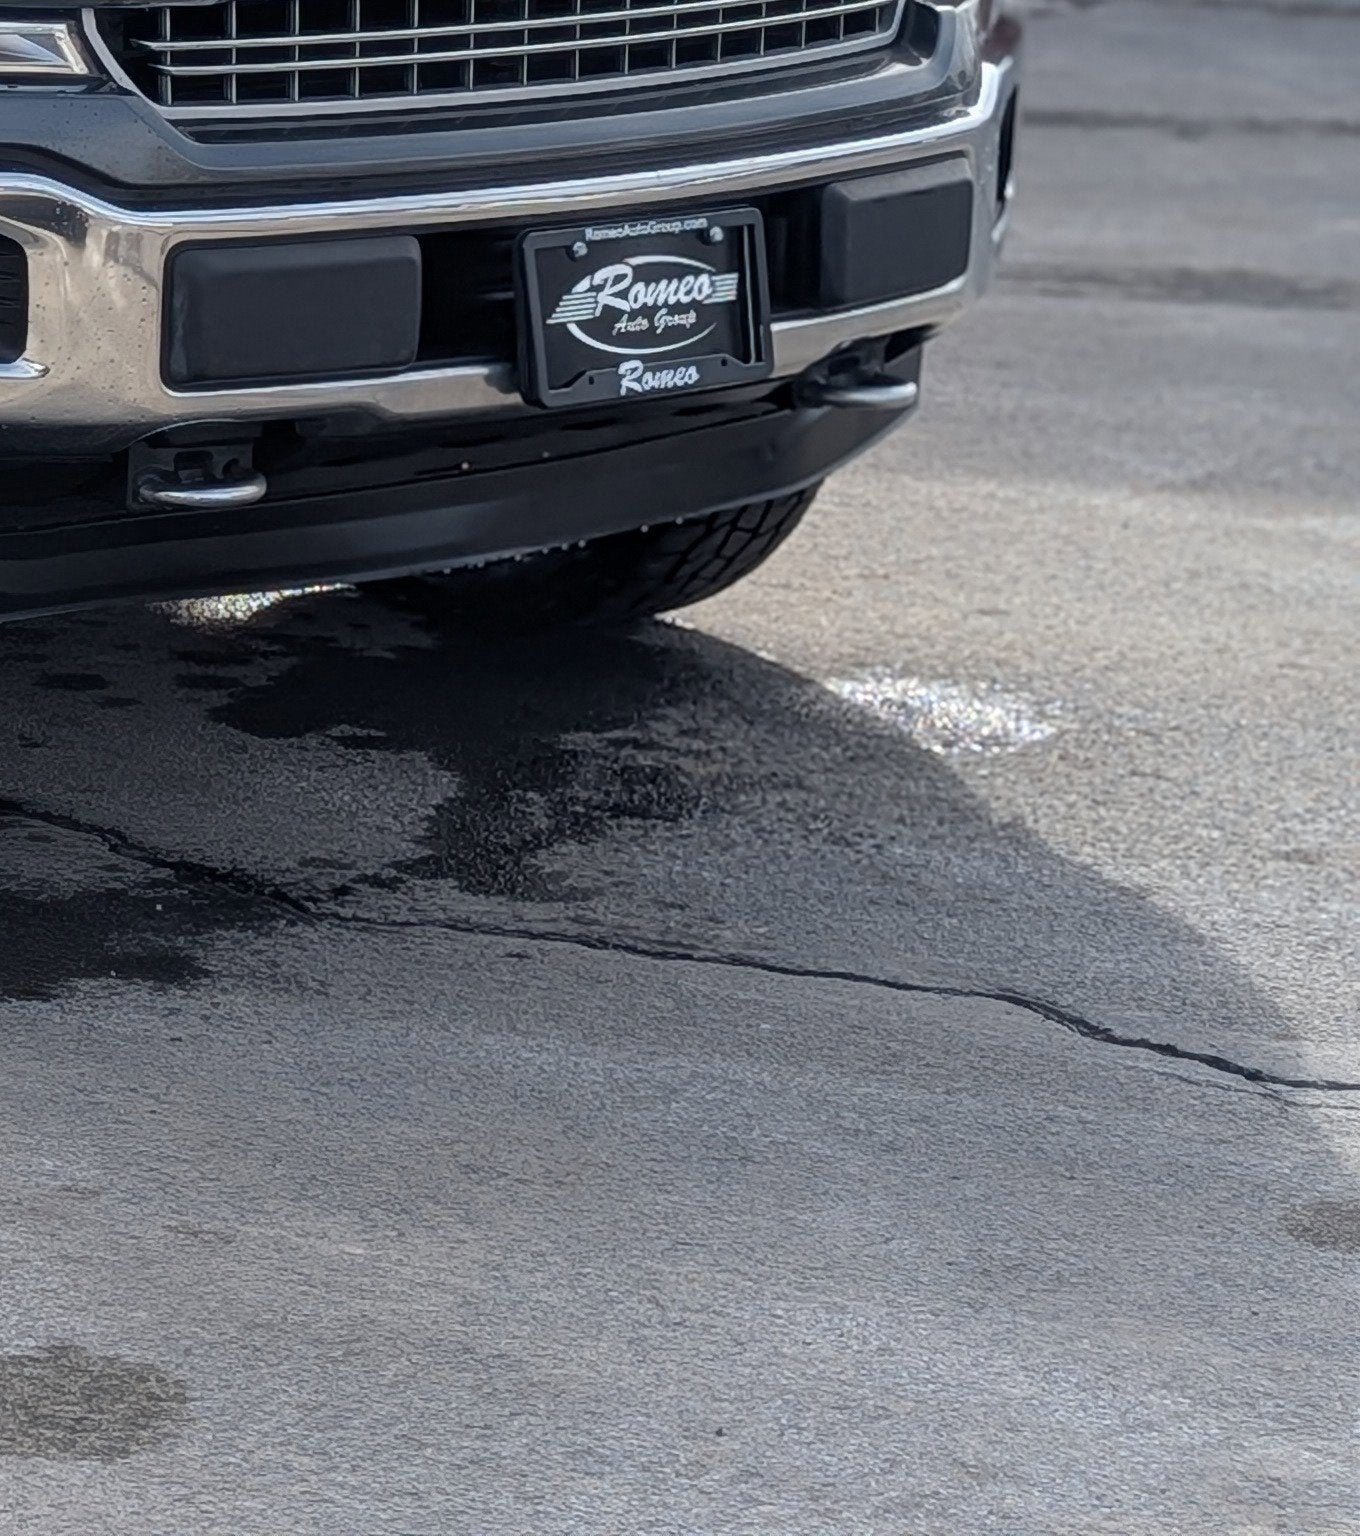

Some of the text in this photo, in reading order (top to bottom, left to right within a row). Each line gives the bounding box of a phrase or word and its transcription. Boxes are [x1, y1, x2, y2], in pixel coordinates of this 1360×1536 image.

[593, 264, 714, 318] Romeo
[612, 308, 698, 335] Auto Group
[618, 360, 700, 396] Romeo
